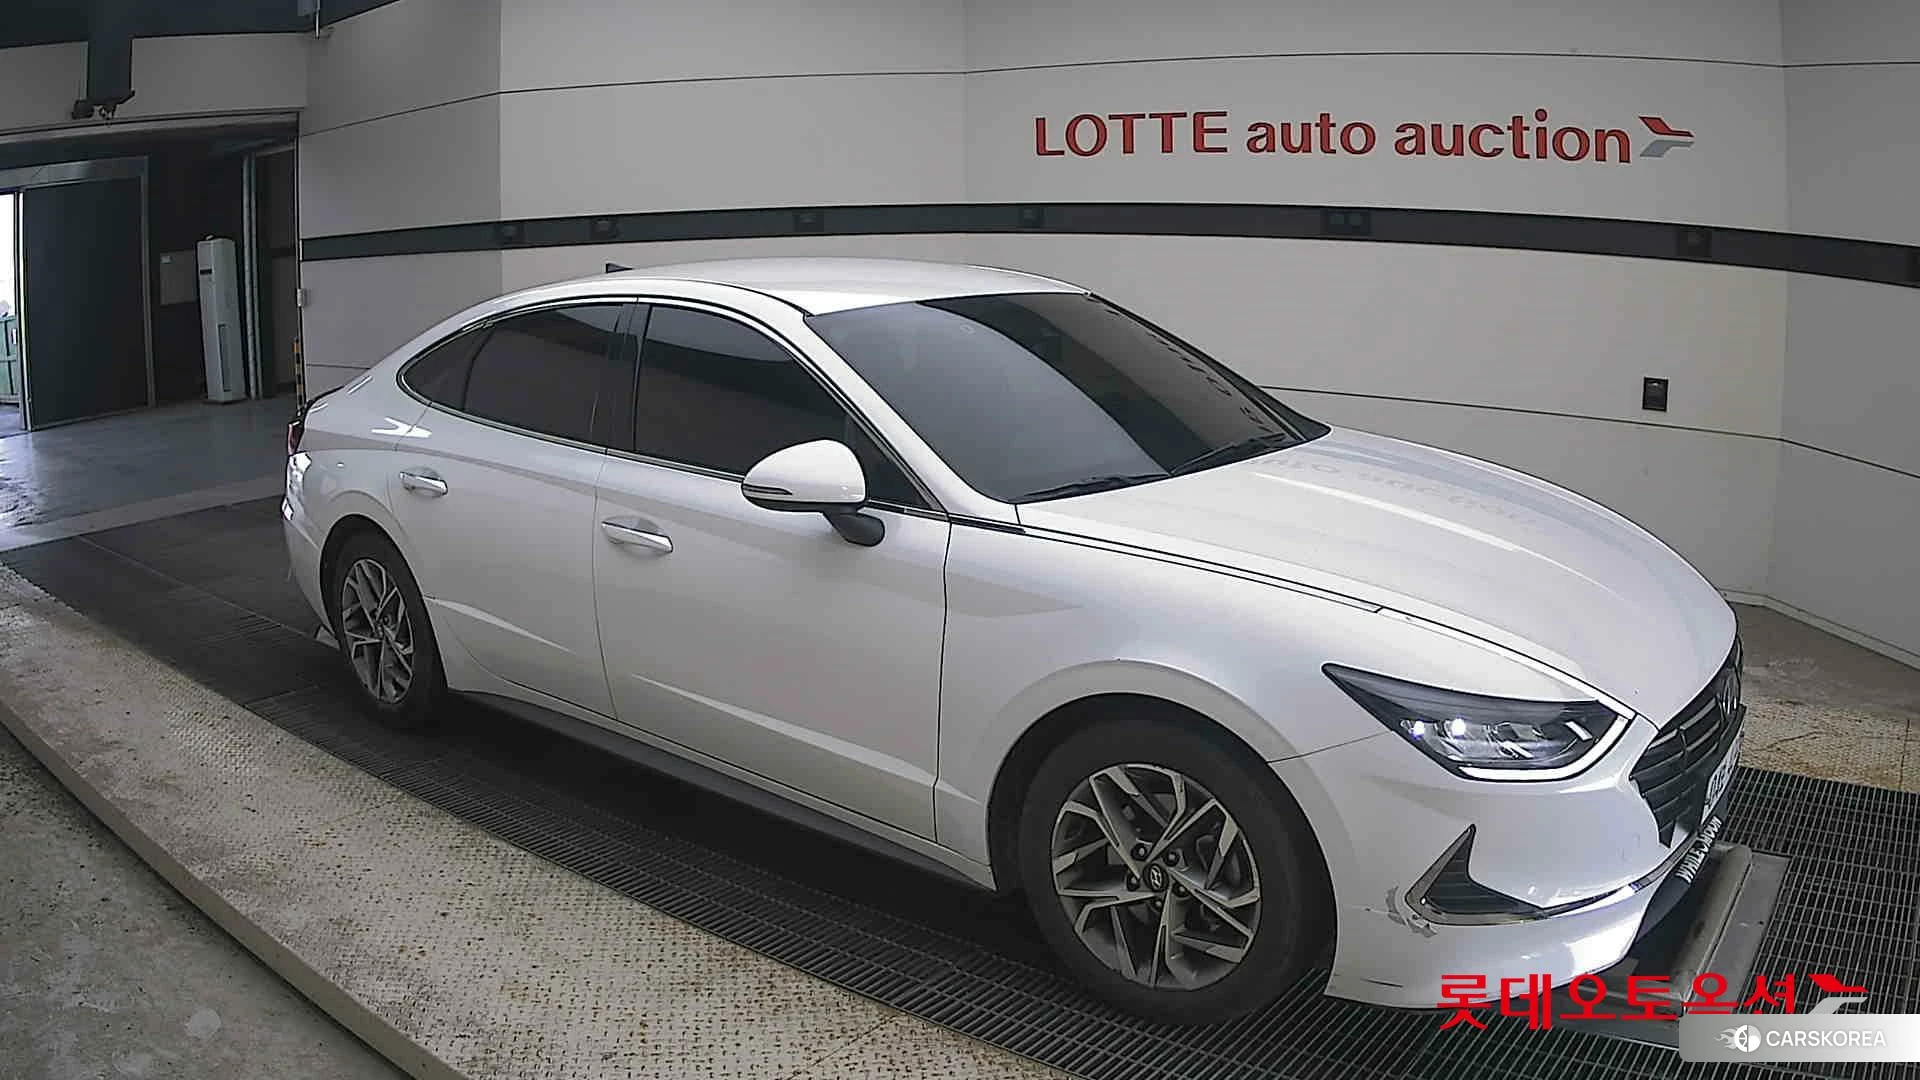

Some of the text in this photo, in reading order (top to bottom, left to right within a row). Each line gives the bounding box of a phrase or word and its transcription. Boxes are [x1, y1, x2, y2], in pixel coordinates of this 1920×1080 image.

[1034, 108, 1632, 163] LOTTE auto auction
